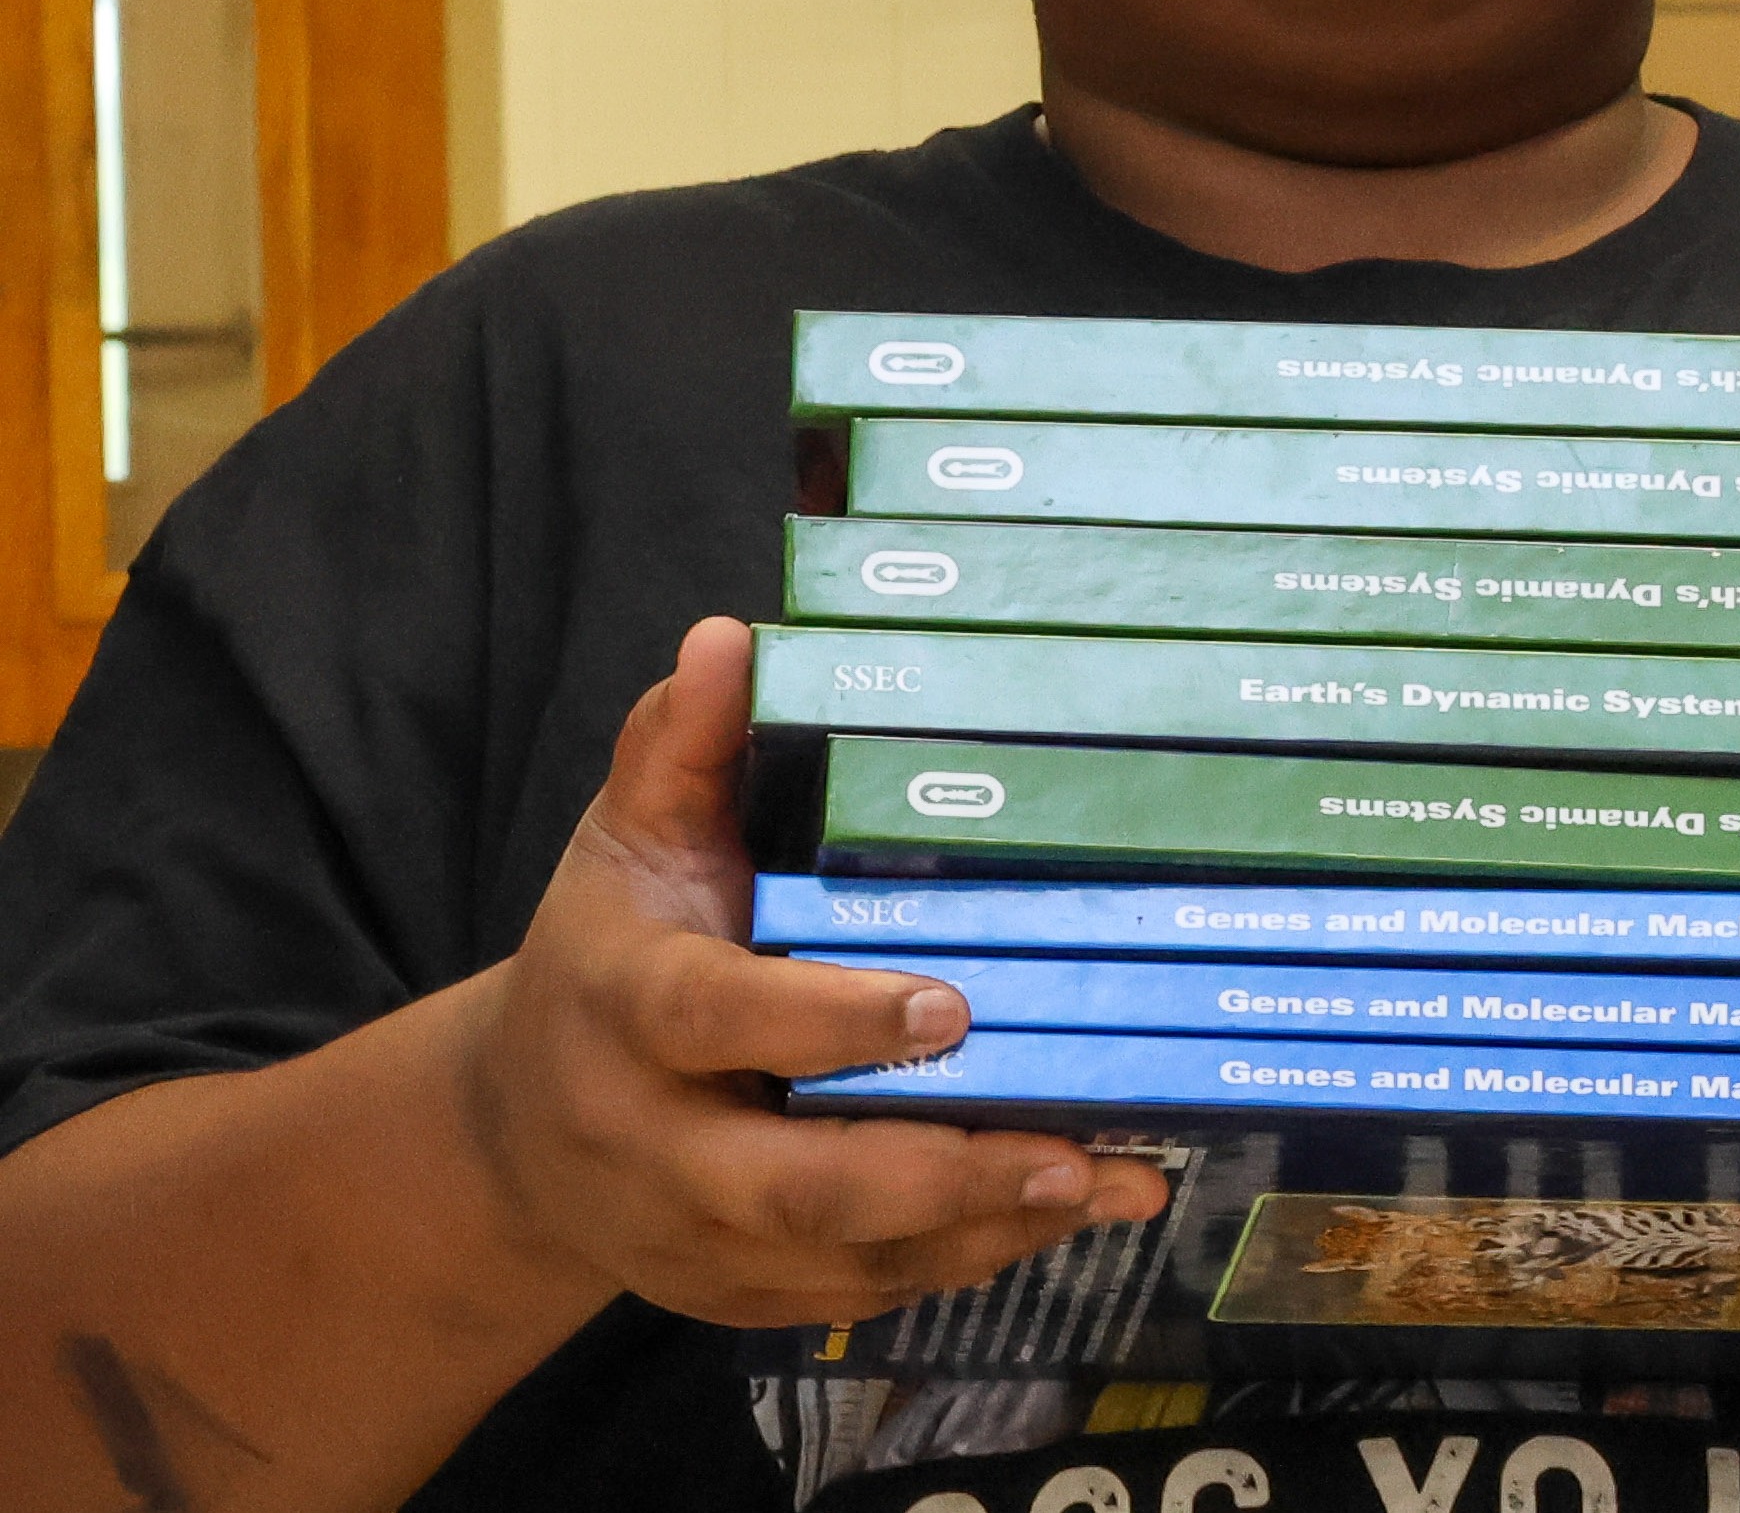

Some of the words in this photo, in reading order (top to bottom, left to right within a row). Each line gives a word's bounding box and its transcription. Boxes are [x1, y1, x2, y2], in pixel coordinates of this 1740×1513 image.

[1277, 358, 1463, 386] Systems
[1477, 363, 1662, 391] Dynamic
[1336, 464, 1522, 493] Systems
[1537, 470, 1721, 497] Dynamic
[1274, 571, 1462, 602] Systems
[1476, 578, 1662, 607] Dynamic
[834, 664, 922, 694] SSEC
[1239, 678, 1388, 706] Earth's
[1402, 683, 1590, 713] Dynamic
[1319, 797, 1507, 829] Systems
[1519, 804, 1706, 836] Dynamic
[831, 898, 919, 927] SSEC
[1174, 904, 1312, 931] Genes
[1324, 909, 1406, 934] and
[1419, 910, 1635, 937] Molecular
[1217, 988, 1355, 1016] Genes
[1368, 994, 1449, 1020] and
[1462, 996, 1677, 1025] Molecular
[1219, 1060, 1357, 1088] Genes
[1370, 1066, 1450, 1092] and
[1464, 1068, 1679, 1097] Molecular
